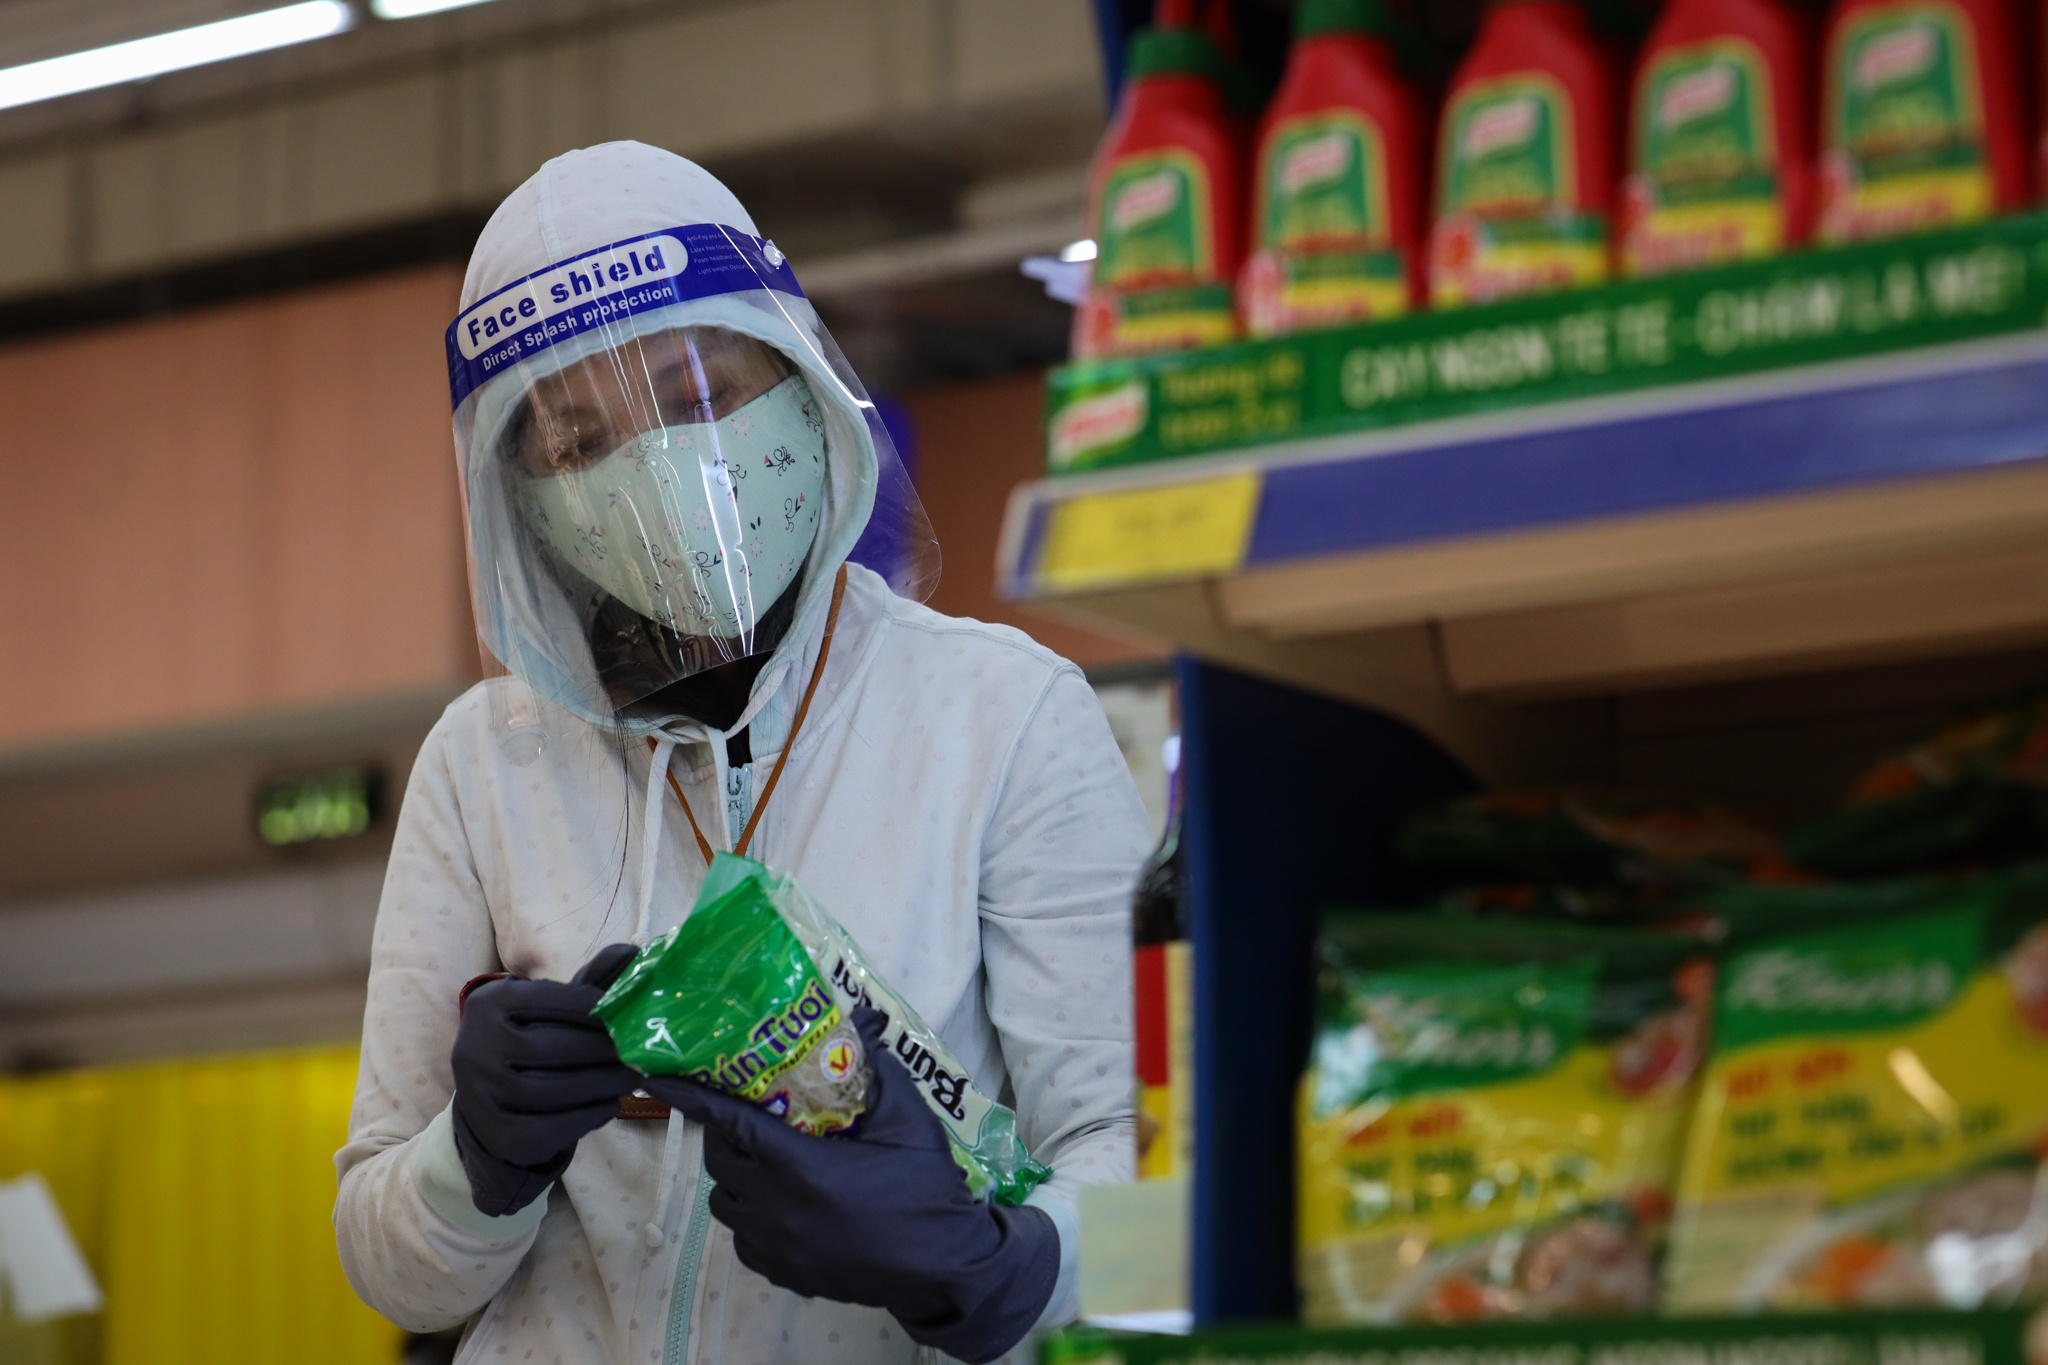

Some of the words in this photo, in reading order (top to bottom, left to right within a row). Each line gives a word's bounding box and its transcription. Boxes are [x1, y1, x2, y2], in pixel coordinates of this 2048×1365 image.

[467, 297, 538, 348] Face
[550, 245, 667, 304] shield
[482, 338, 522, 371] Direct
[525, 313, 578, 348] Splash
[582, 286, 673, 326] protection
[896, 1031, 970, 1122] Bún
